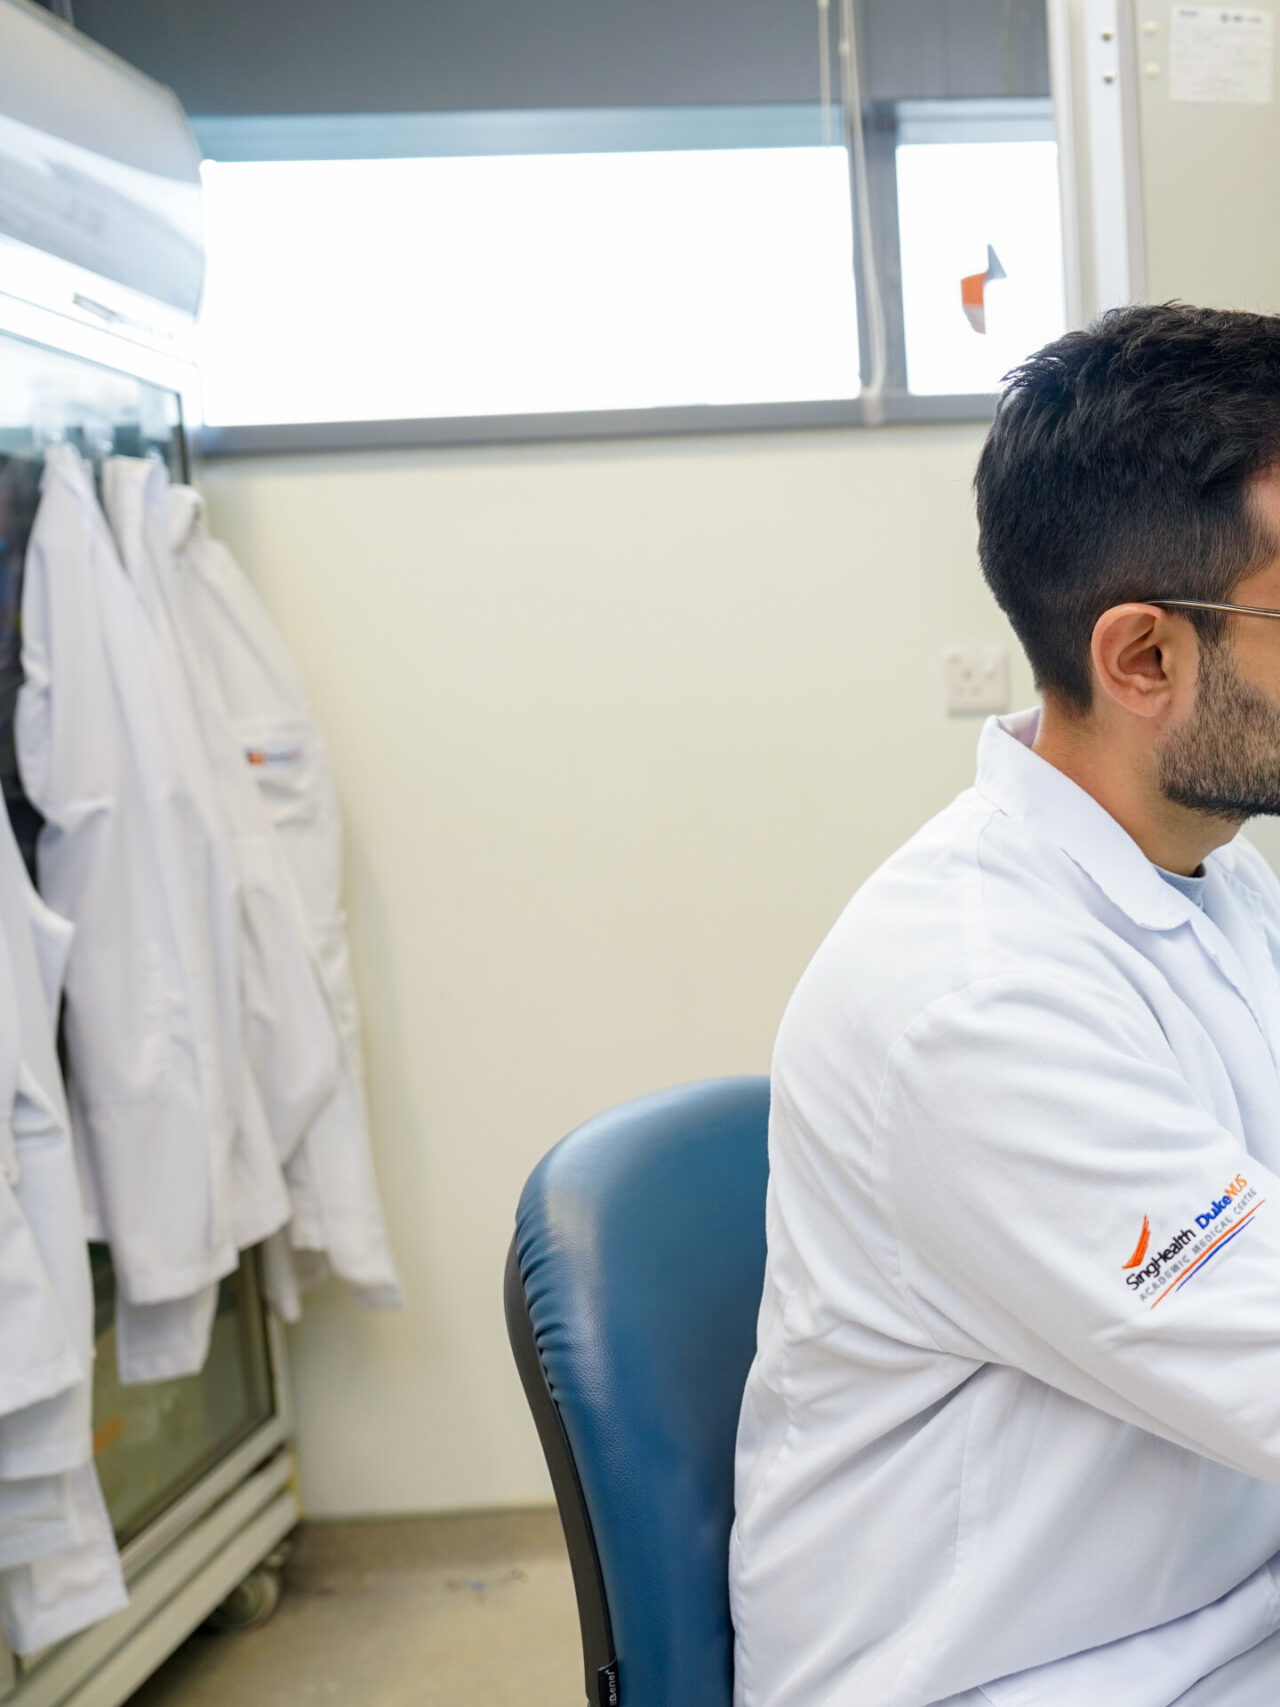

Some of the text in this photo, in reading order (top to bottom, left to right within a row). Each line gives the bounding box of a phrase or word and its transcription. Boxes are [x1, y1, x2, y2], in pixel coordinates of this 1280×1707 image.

[1126, 1227, 1197, 1291] SingHealth
[1139, 1187, 1257, 1302] ACADEMIC MEDICAL CENTRE
